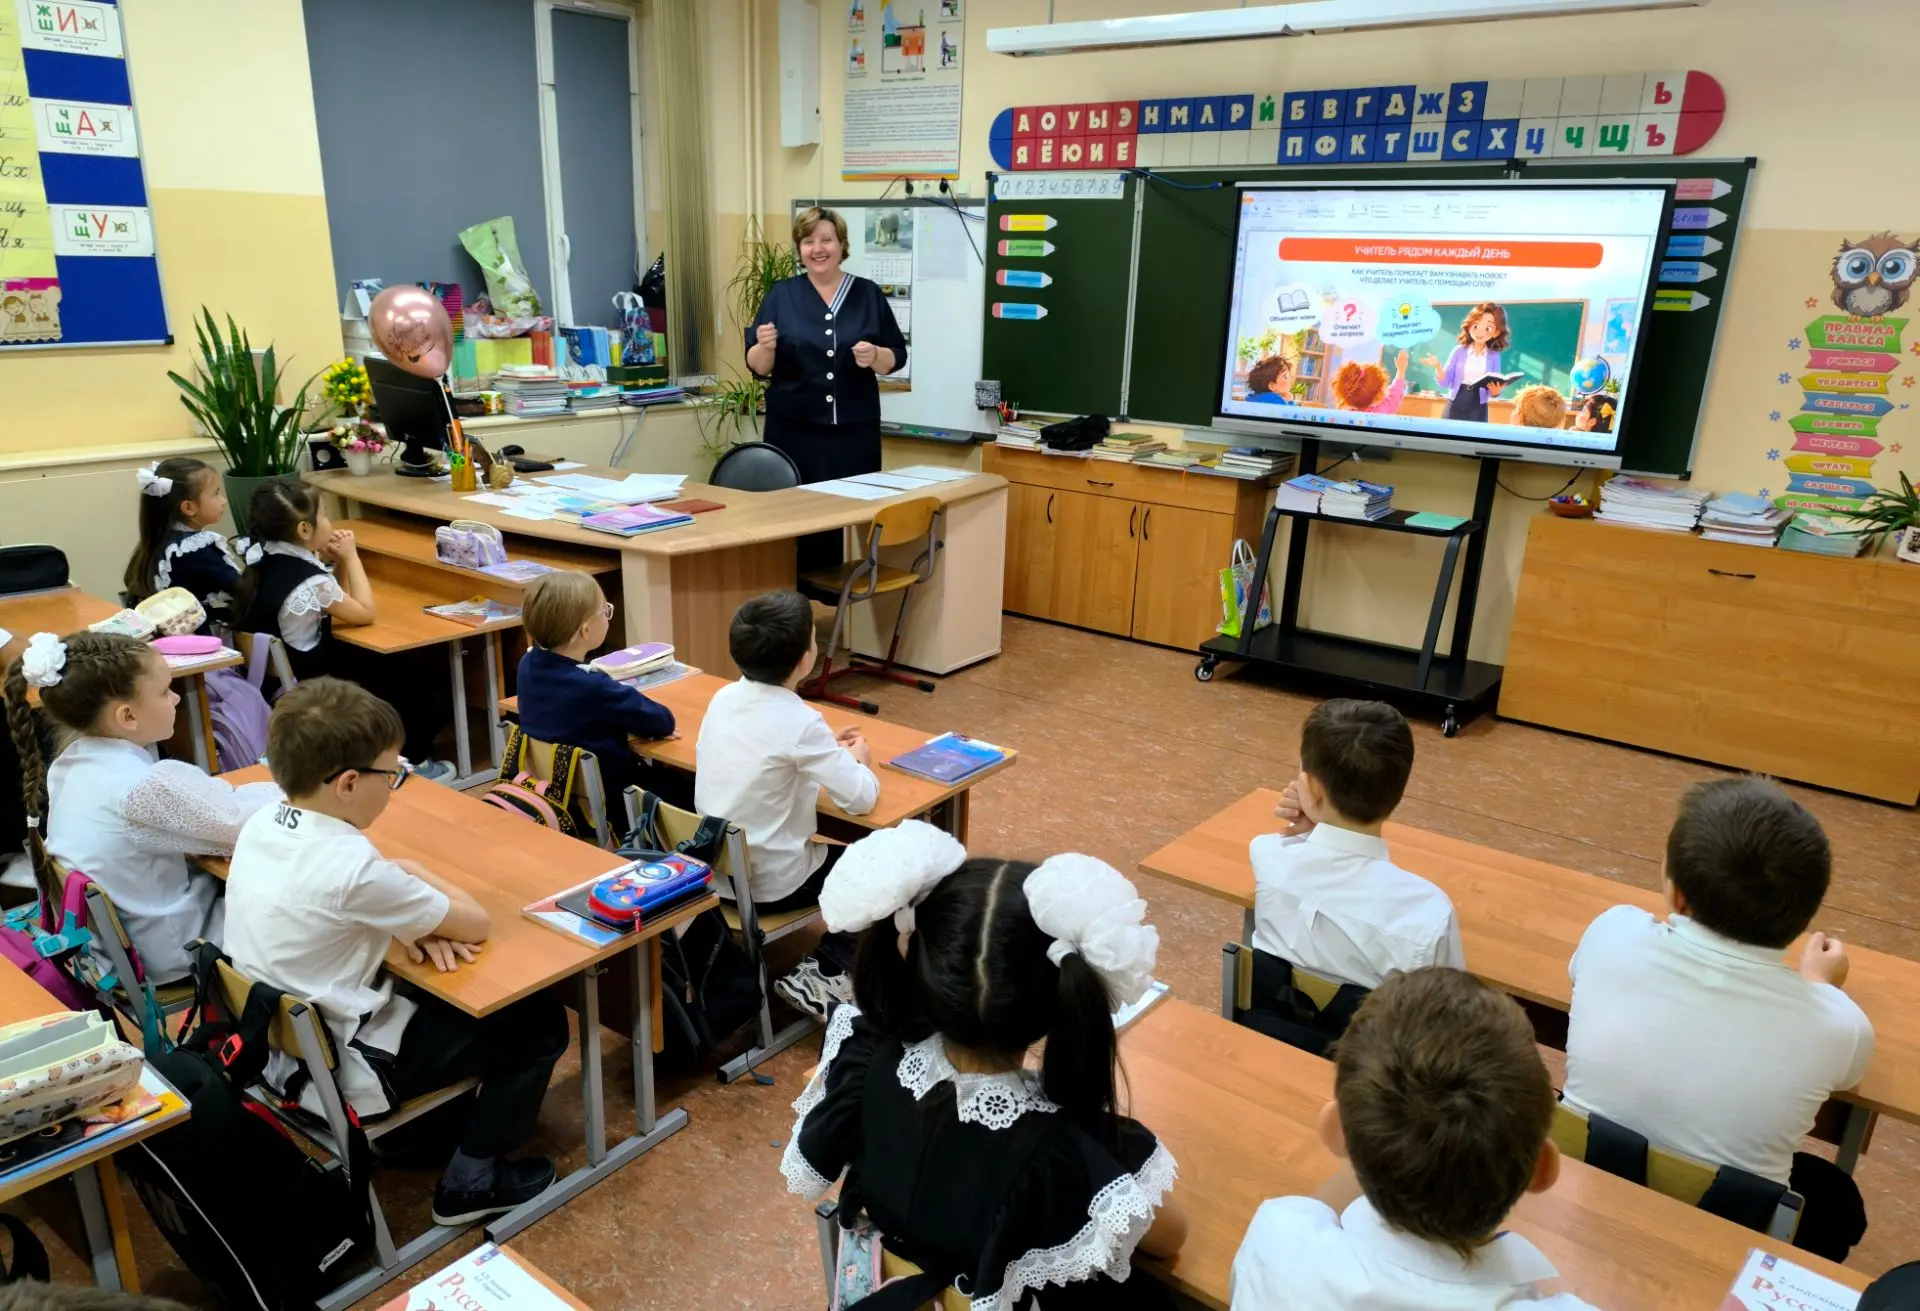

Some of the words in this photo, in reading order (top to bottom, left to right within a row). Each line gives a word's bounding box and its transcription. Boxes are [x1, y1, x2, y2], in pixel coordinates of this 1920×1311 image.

[36, 4, 52, 17] Ж
[38, 18, 54, 31] Ш
[56, 6, 79, 34] И
[1017, 114, 1030, 132] А
[1041, 112, 1057, 131] О
[1067, 111, 1081, 130] У
[1089, 110, 1108, 129] Ы
[1118, 108, 1132, 127] Э
[1144, 107, 1159, 125] Н
[1170, 106, 1190, 125] М
[1200, 105, 1215, 124] Л
[1230, 103, 1245, 123] Р
[1259, 95, 1275, 122] Й
[1290, 100, 1305, 120] Б
[1322, 98, 1338, 119] В
[1355, 95, 1371, 118] Г
[1384, 93, 1406, 117] Д
[1416, 92, 1445, 115] Ж
[1458, 90, 1474, 113] З
[1653, 81, 1673, 105] Ь
[59, 108, 69, 120] Ч
[55, 121, 73, 136] Щ
[76, 110, 97, 137] А
[1016, 146, 1028, 164] Я
[1041, 139, 1053, 163] Ё
[1062, 144, 1082, 162] Ю
[1090, 143, 1104, 162] И
[1116, 141, 1129, 161] Е
[1286, 136, 1303, 157] П
[1314, 135, 1337, 156] Ф
[1350, 134, 1366, 155] К
[1384, 132, 1401, 154] Т
[1413, 131, 1439, 153] Ш
[1451, 129, 1470, 151] С
[1486, 127, 1506, 150] Х
[1524, 127, 1545, 154] Ц
[1565, 126, 1584, 148] Ч
[1599, 124, 1630, 152] Щ
[1645, 124, 1666, 147] Ъ
[78, 213, 87, 223] Ч
[74, 225, 91, 239] Щ
[91, 213, 109, 239] У
[1354, 246, 1396, 256] УЧИТЕЛЬ
[1398, 246, 1433, 258] РЯДОМ
[1434, 246, 1480, 259] КАЖДЫЙ
[1482, 248, 1511, 260] ДЕНЬ
[1824, 322, 1896, 336] ПРАВИЛА
[1826, 334, 1886, 347] КЛАССА
[1827, 356, 1876, 367] УЧИТЬСЯ
[1817, 378, 1880, 389] ТРУДИТЬСЯ
[1815, 398, 1875, 412] СТАРАТЬСЯ
[1812, 420, 1864, 430] ДРУЖИТЬ
[1810, 438, 1860, 451] МЕЧТАТЬ
[1812, 462, 1853, 472] ЧИТАТЬ
[1804, 480, 1855, 494] СЛУШАТЬ
